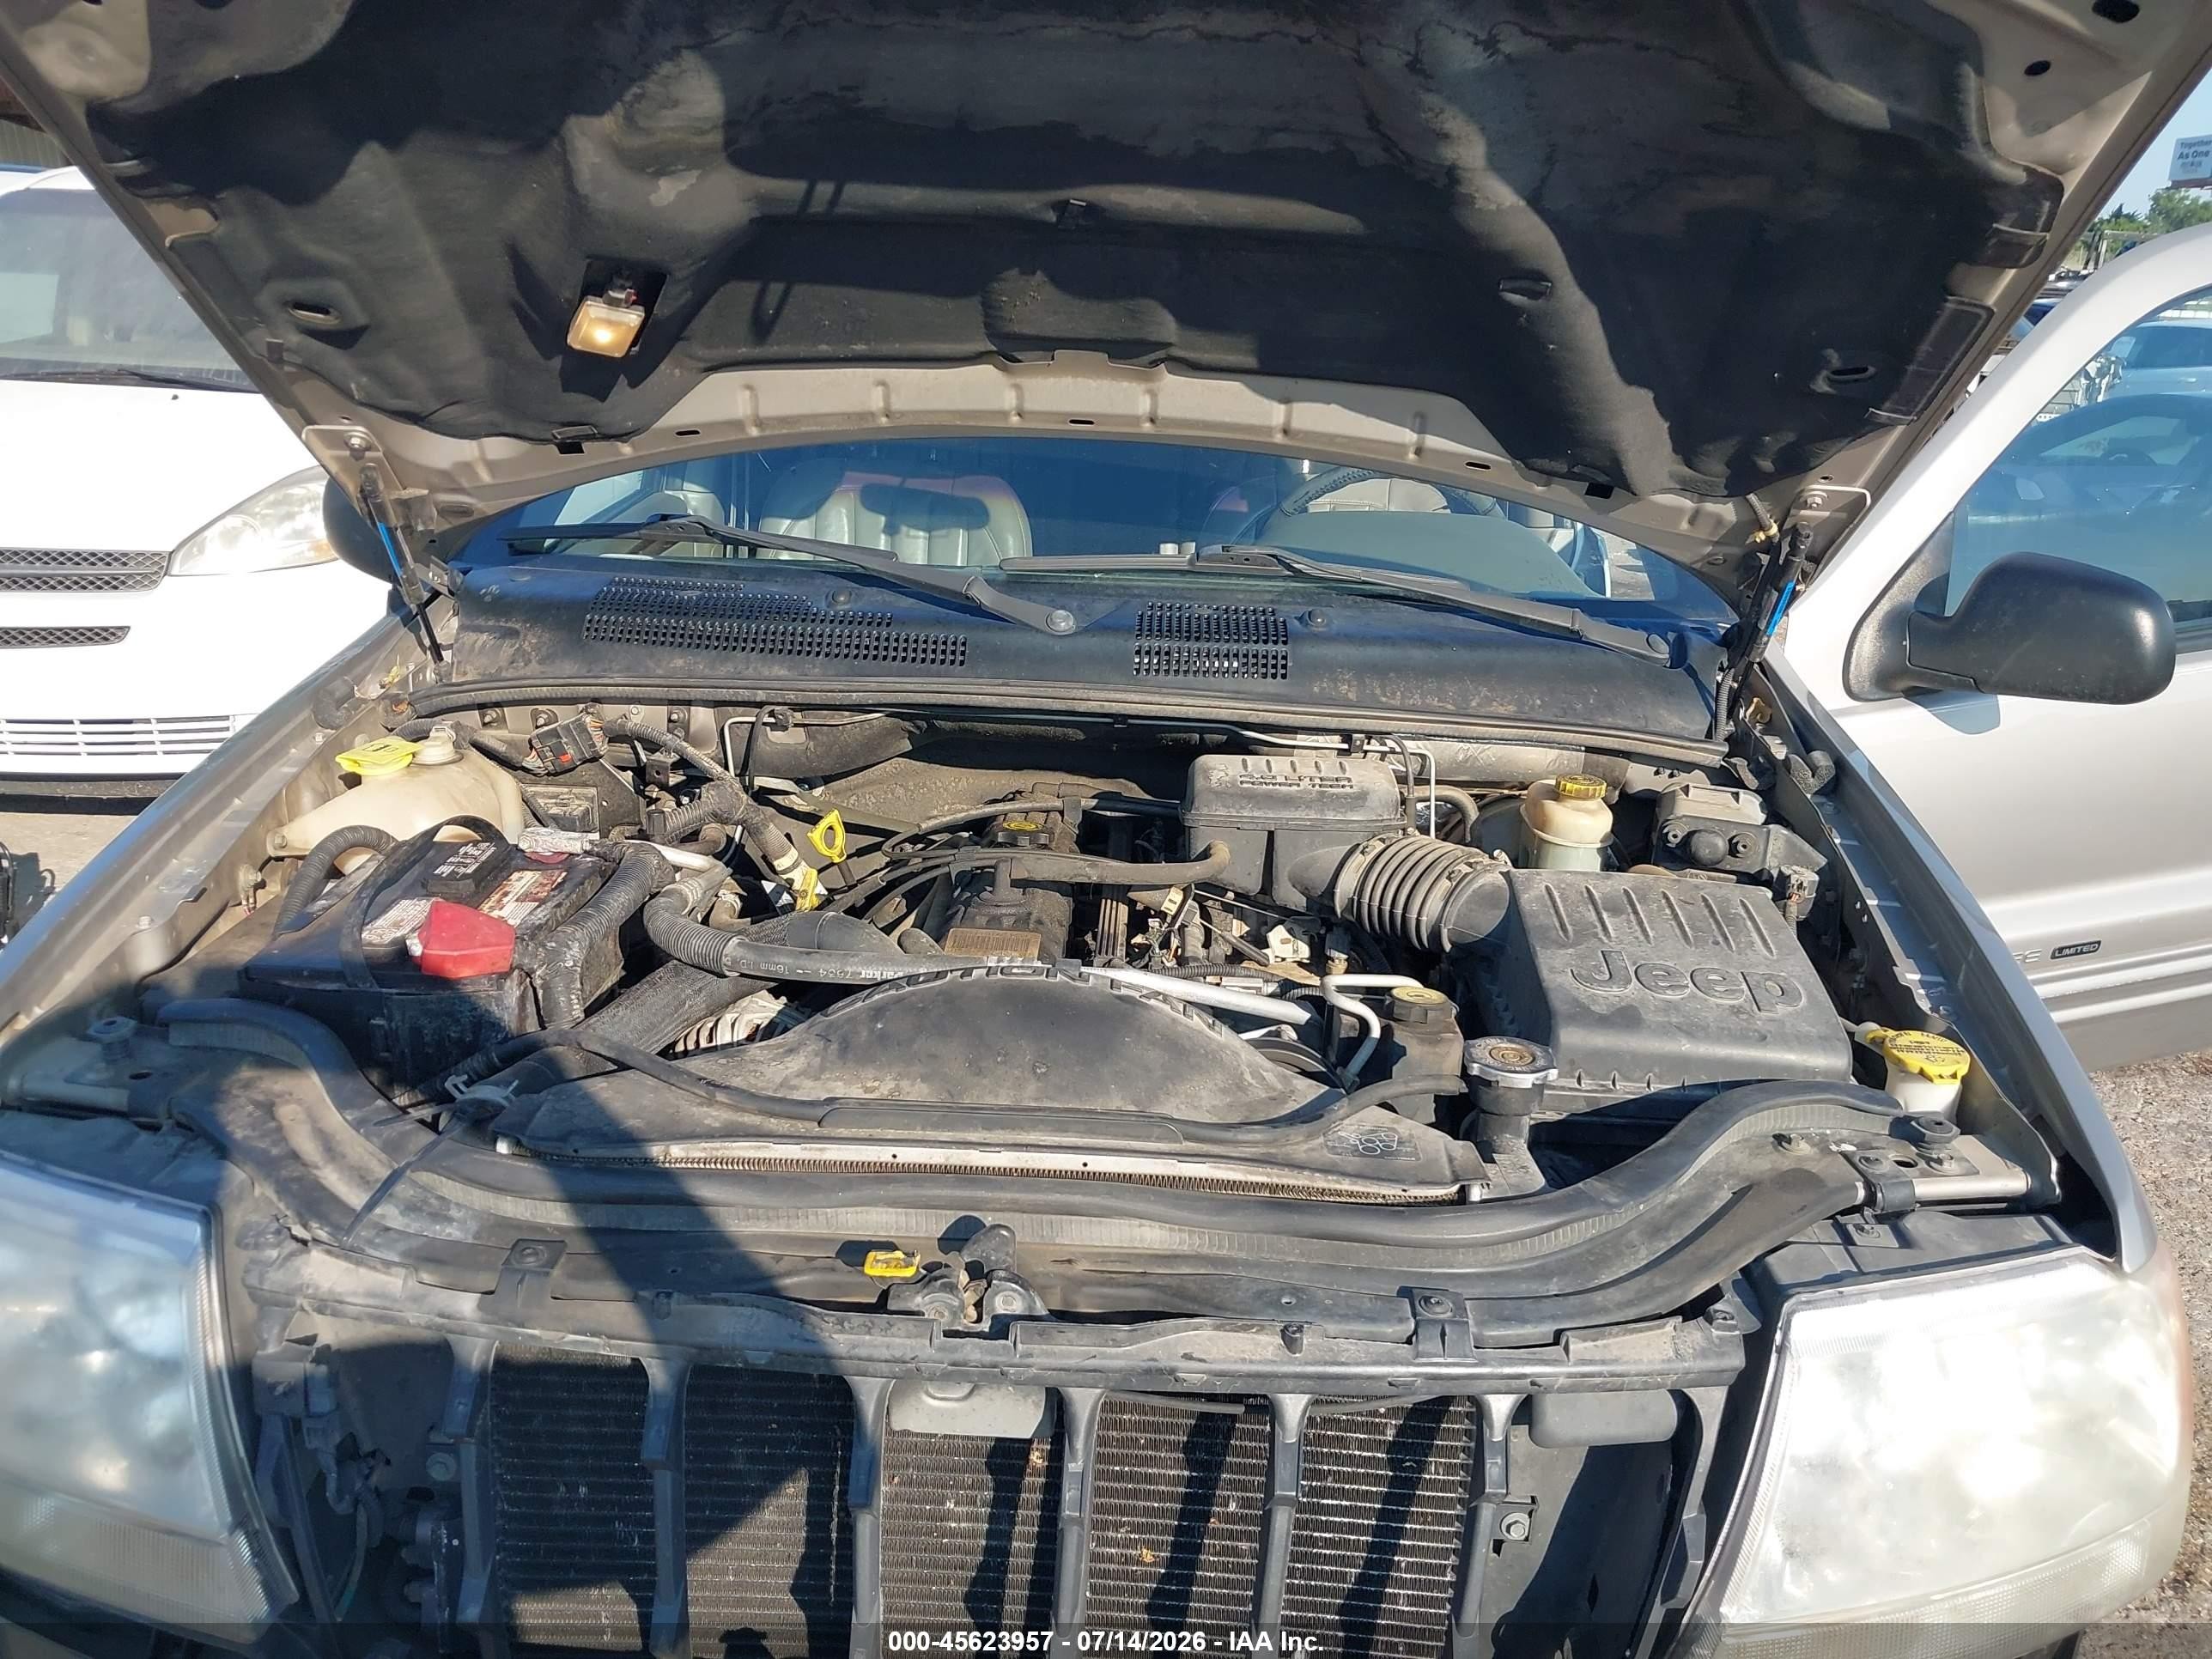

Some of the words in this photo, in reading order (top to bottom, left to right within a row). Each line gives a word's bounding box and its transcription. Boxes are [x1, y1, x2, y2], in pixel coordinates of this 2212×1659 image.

[2177, 151, 2190, 160] As
[1239, 780, 1302, 788] POWER
[2054, 943, 2099, 957] LIMITED
[1569, 949, 1804, 1015] Jeep
